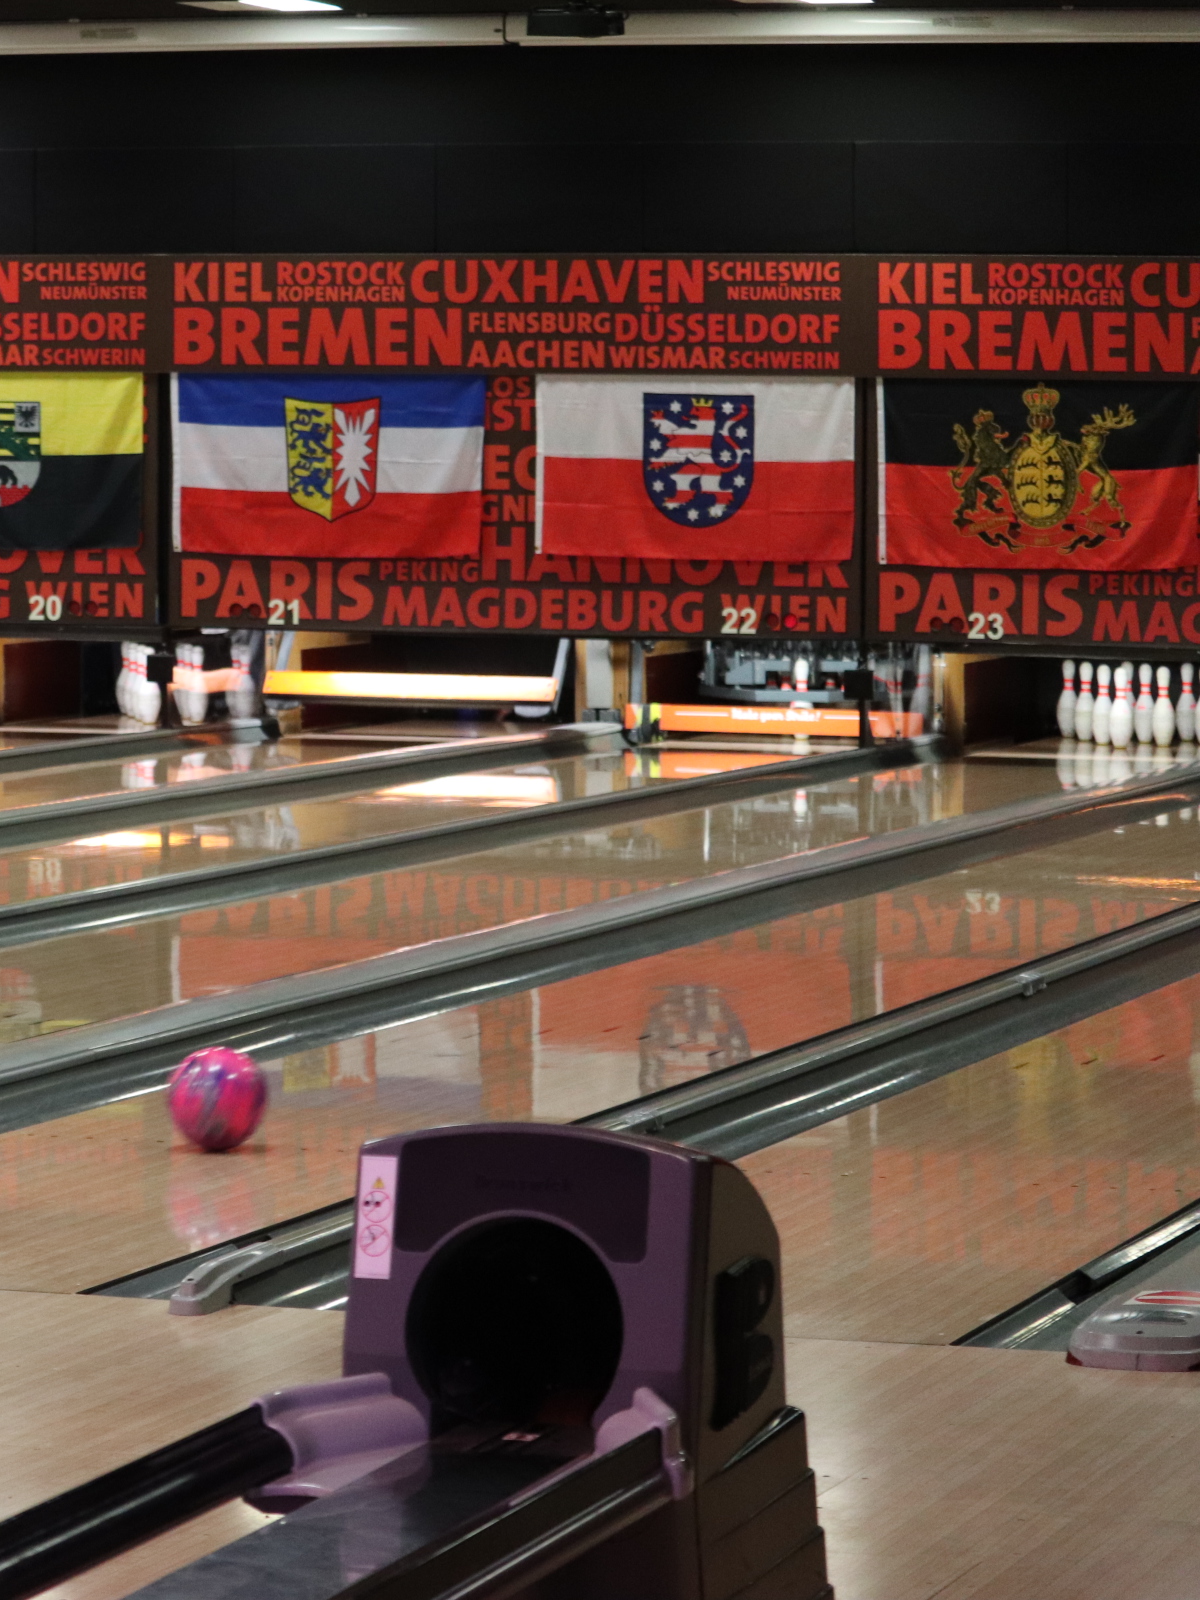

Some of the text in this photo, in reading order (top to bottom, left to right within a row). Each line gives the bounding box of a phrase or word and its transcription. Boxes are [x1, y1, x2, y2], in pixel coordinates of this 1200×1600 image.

[22, 261, 146, 282] SCHLESWIG
[173, 259, 840, 303] KIEL ROSTOCK CUXHAVEN SCHLESWIG
[878, 262, 983, 305] KIEL
[988, 263, 1124, 289] ROSTOCK
[40, 282, 147, 300] NEUMÜNSTER
[276, 282, 841, 303] KOPENHAGEN NEUMÜNSTER
[988, 288, 1124, 307] KOPENHAGEN
[173, 305, 840, 366] BREMEN FLENSBURG DÜSSELDORF
[878, 309, 1185, 372] BREMEN
[42, 348, 146, 366] SCHWERIN
[467, 340, 840, 370] AACHEN WISMAR SCHWERIN
[25, 581, 143, 618] WIEN
[181, 558, 480, 621] PARIS PEKING
[878, 571, 1194, 637] PARIS PEKING
[28, 594, 62, 621] 20
[268, 599, 300, 625] 21
[382, 586, 847, 633] MAGDEBURG WIEN
[721, 607, 757, 634] 22
[967, 612, 1004, 640] 23
